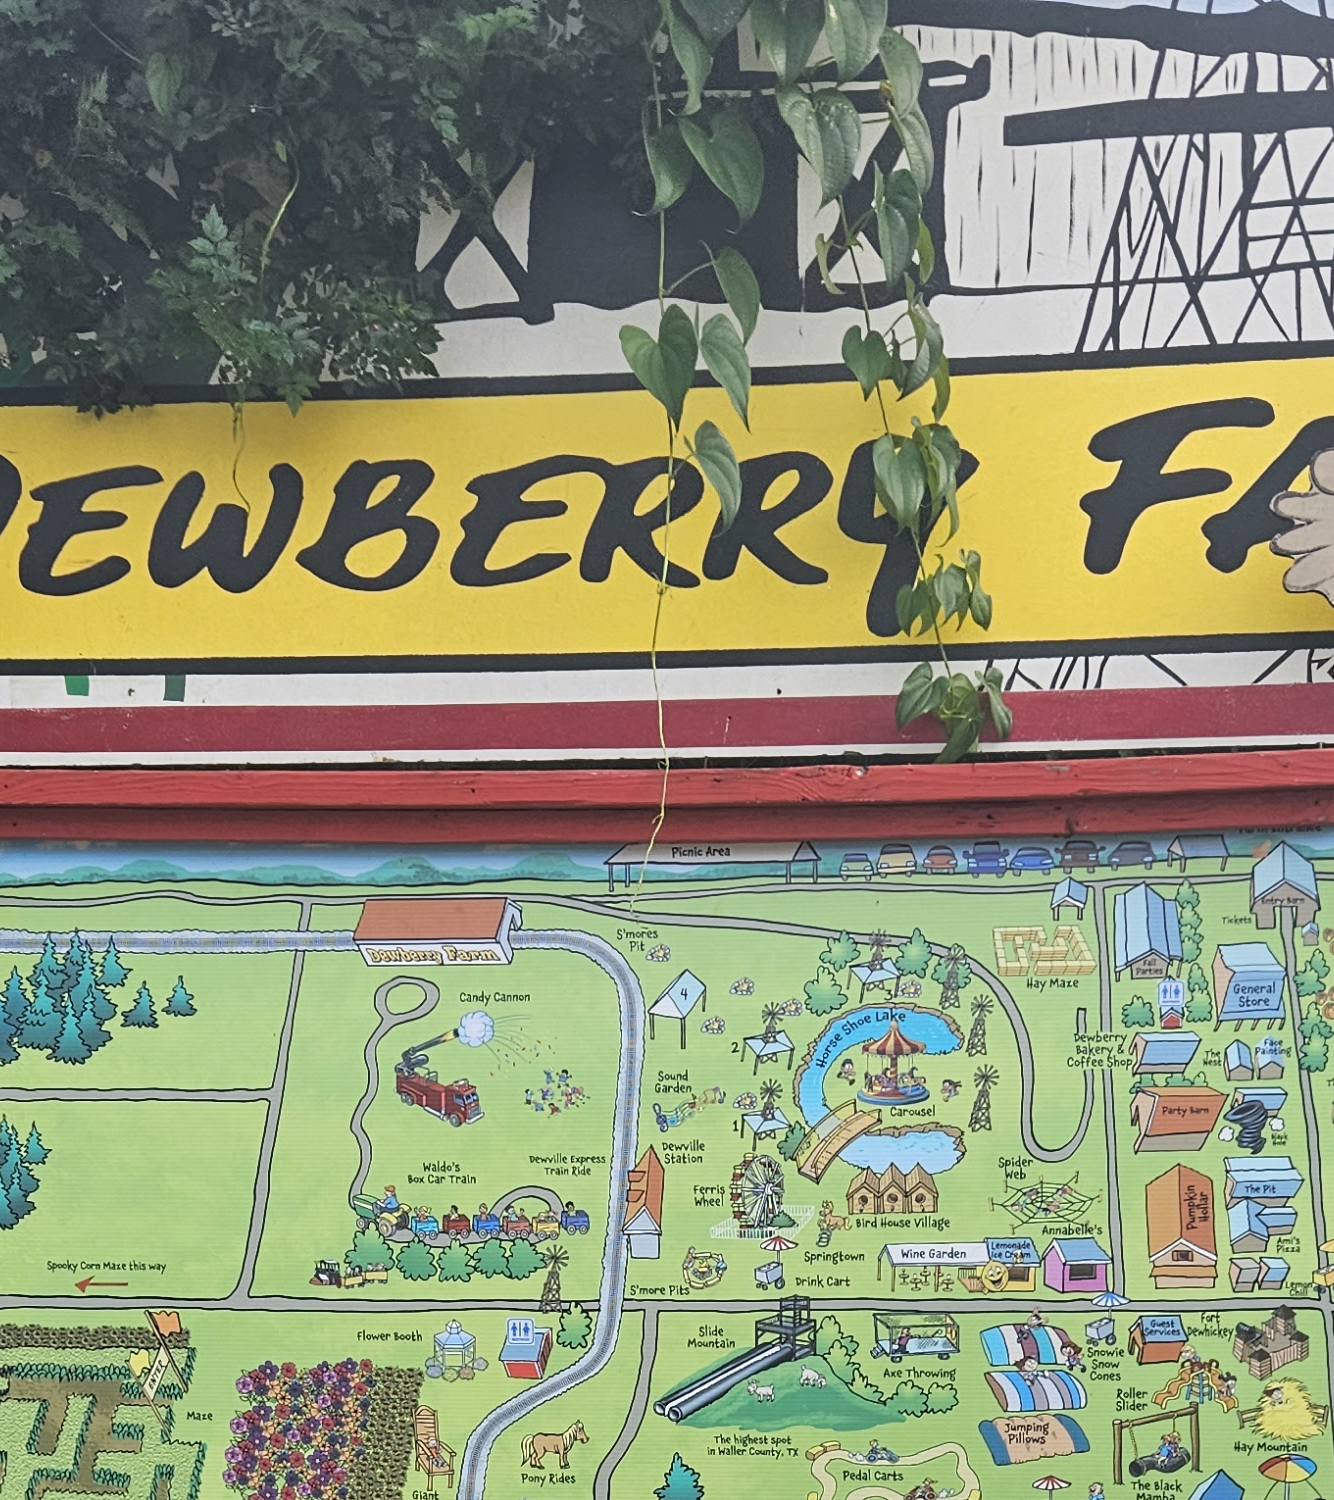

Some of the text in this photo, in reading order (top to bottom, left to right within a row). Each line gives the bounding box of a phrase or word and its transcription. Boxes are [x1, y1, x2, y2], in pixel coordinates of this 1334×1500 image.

[671, 846, 730, 858] Picnic Area
[617, 928, 658, 939] S'mores
[629, 940, 645, 952] Pit
[368, 946, 500, 964] Dewberry Farm
[1027, 978, 1079, 990] Hay Maze
[1233, 983, 1276, 995] General
[459, 992, 530, 1004] Candy Cannon
[680, 988, 688, 1000] 4
[884, 989, 892, 1001] 3
[1239, 996, 1269, 1007] Store
[816, 1008, 906, 1068] Horse Shoe Lake
[1074, 1033, 1127, 1046] Dewberry
[1264, 1038, 1283, 1048] Face
[1204, 1051, 1220, 1059] The
[1255, 1046, 1291, 1058] Painting
[1067, 1056, 1132, 1071] Coffee Shop
[658, 1071, 688, 1082] Sound
[655, 1082, 692, 1094] Garden
[890, 1106, 936, 1117] Carousel
[1162, 1105, 1209, 1117] Party Barn
[662, 1142, 705, 1152] Dewville
[529, 1154, 606, 1166] Dewville Express
[665, 1153, 703, 1164] Station
[999, 1157, 1033, 1170] Spider
[423, 1162, 460, 1173] Waldo's
[545, 1166, 591, 1176] Train Ride
[408, 1174, 476, 1184] Box Car Train
[1005, 1169, 1026, 1180] Web
[693, 1185, 725, 1195] Ferris
[1245, 1184, 1277, 1193] The Pit
[695, 1196, 724, 1207] Wheel
[1187, 1184, 1197, 1230] Pumpkin
[856, 1218, 950, 1230] Bird House Village
[1042, 1224, 1103, 1236] Annabelle's
[991, 1240, 1031, 1250] Lemonade
[804, 1251, 865, 1263] Springtown
[901, 1248, 966, 1259] Wine Garden
[47, 1260, 166, 1274] Spooky Corn Maze this way
[795, 1276, 851, 1287] Drink Cart
[630, 1285, 690, 1296] S'more Pits
[1151, 1319, 1175, 1328] Guest
[1200, 1313, 1220, 1324] Fort
[357, 1331, 423, 1342] Flower Booth
[699, 1326, 724, 1337] Slide
[1145, 1328, 1181, 1338] Services
[1187, 1325, 1234, 1339] Dewhickey
[688, 1338, 735, 1349] Mountain
[1087, 1347, 1125, 1358] Snowie
[1092, 1359, 1119, 1370] Snow
[148, 1360, 166, 1390] ENTER
[884, 1368, 955, 1381] Axe Throwing
[1090, 1371, 1121, 1381] Cones
[1117, 1388, 1148, 1399] Roller
[1116, 1400, 1148, 1411] Slider
[187, 1411, 213, 1421] Maze
[1005, 1422, 1049, 1435] Jumping
[714, 1434, 791, 1446] The highest spot
[1008, 1433, 1046, 1444] Pillows
[1234, 1442, 1308, 1453] Hay Mountain
[521, 1473, 576, 1486] Pony Rides
[843, 1470, 903, 1481] Pedal Carts
[1130, 1481, 1182, 1492] The Black
[412, 1491, 439, 1500] Giant
